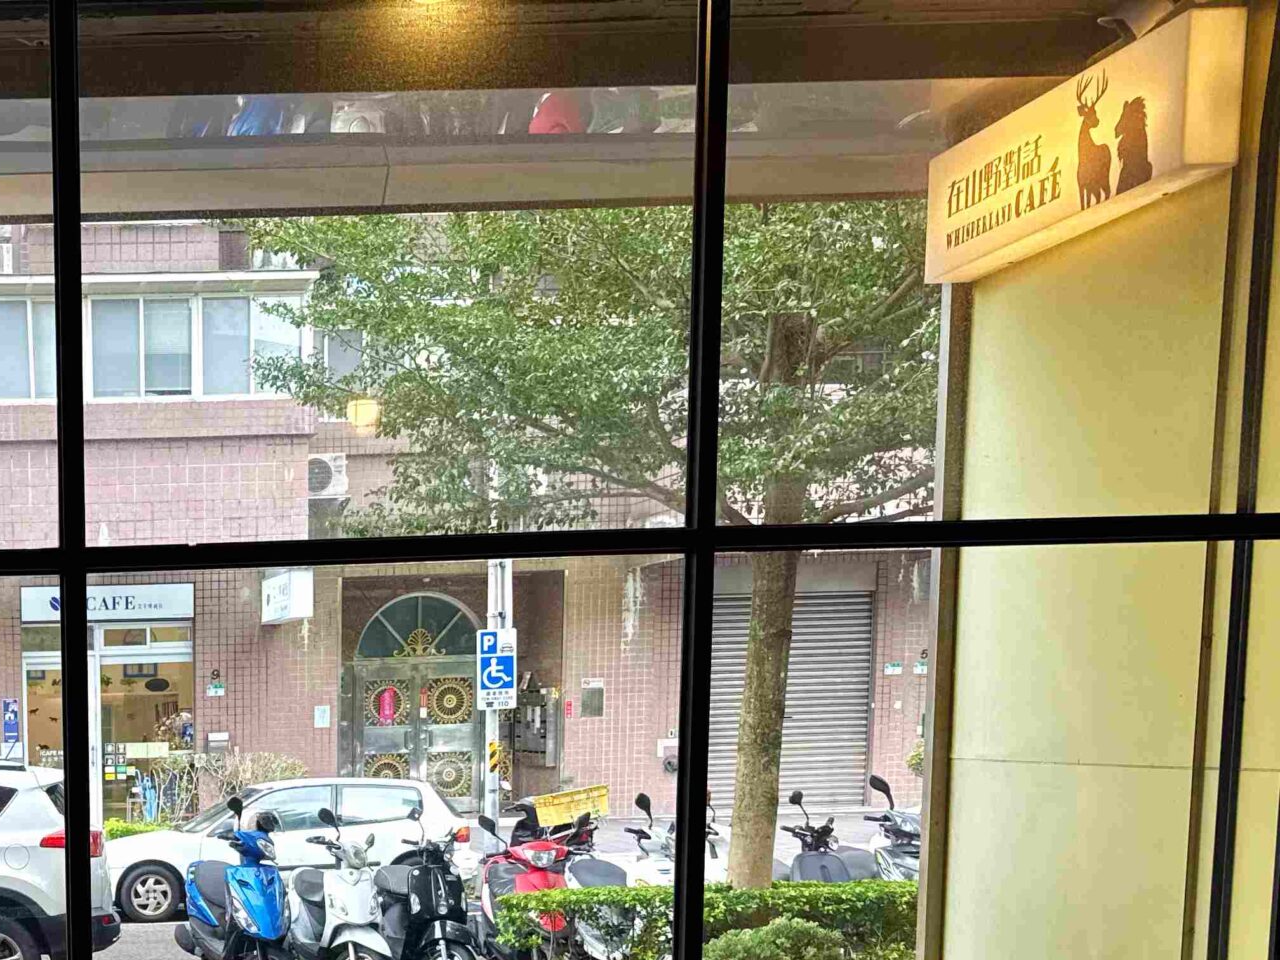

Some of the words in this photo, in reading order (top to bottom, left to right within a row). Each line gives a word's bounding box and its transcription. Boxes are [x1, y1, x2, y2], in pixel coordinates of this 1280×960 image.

[947, 135, 1043, 218] 在山野對話
[945, 203, 1014, 251] WHISPERLAND
[483, 635, 495, 652] P
[211, 669, 220, 680] 9
